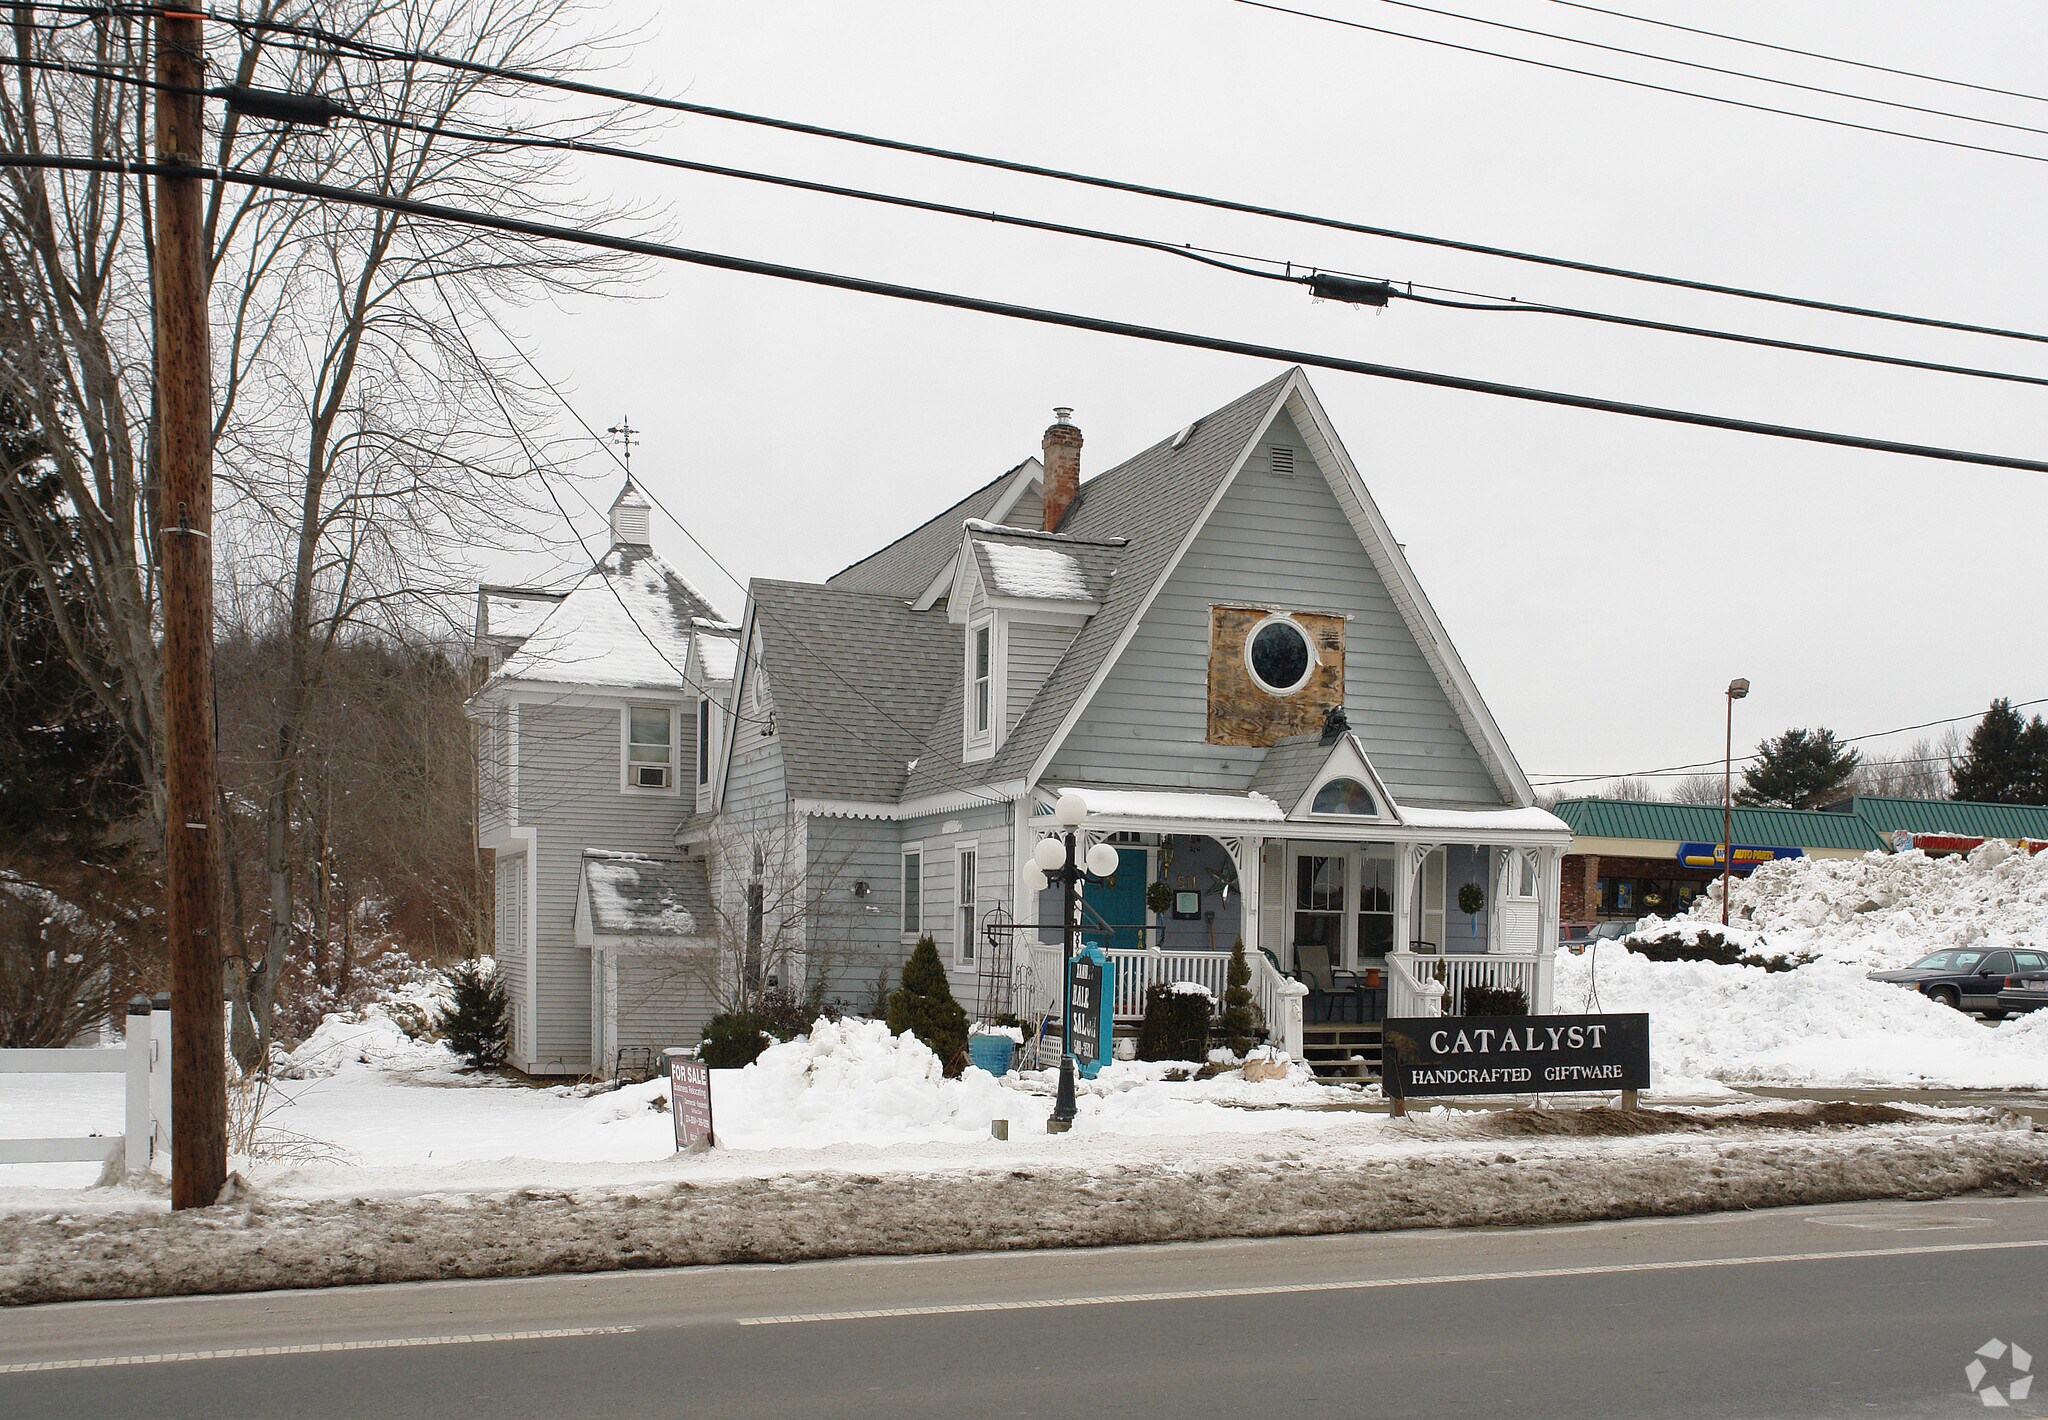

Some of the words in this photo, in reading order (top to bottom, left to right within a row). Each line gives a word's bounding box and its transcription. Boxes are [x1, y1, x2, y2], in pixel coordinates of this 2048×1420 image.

[1733, 849, 1752, 860] AUTO
[1753, 850, 1775, 860] PARTS
[1429, 1024, 1607, 1055] CATALYST
[671, 1063, 686, 1082] FOR
[687, 1066, 707, 1086] SALE
[1411, 1067, 1532, 1085] HANDCRAFTED
[1544, 1064, 1623, 1081] GIFTWARE
